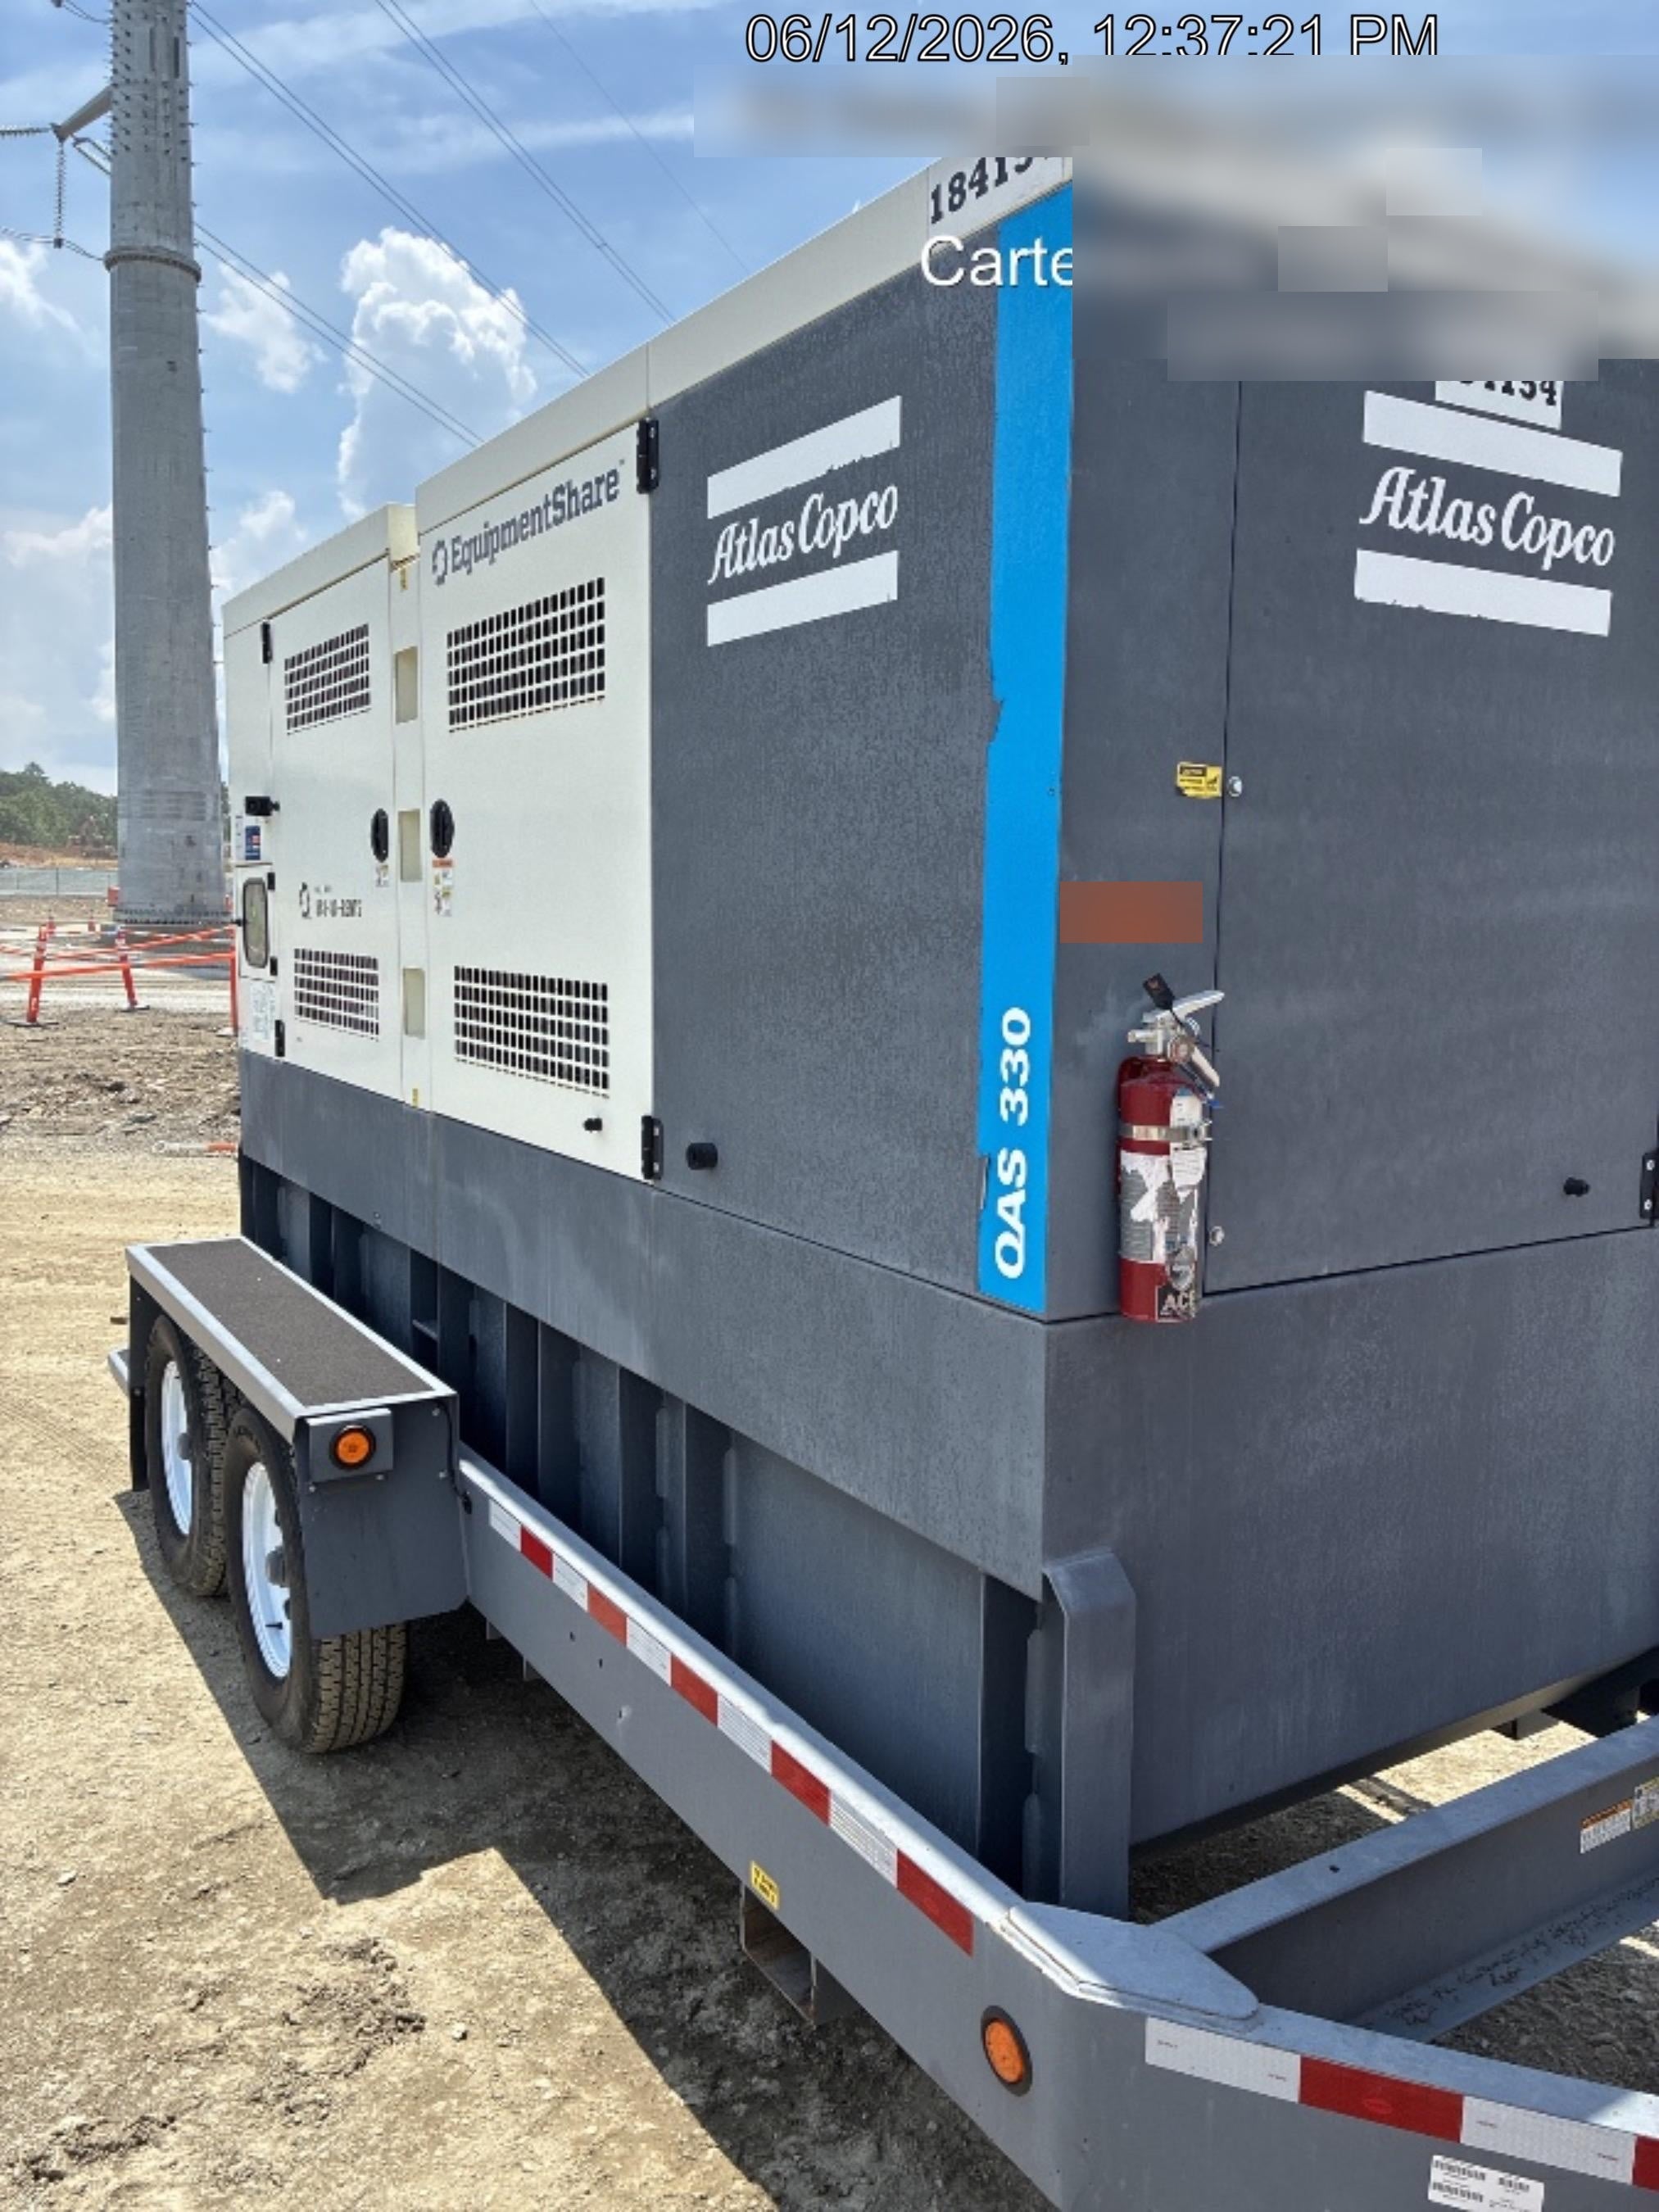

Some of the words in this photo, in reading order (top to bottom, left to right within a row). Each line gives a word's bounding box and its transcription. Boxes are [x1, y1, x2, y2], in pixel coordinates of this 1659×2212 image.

[451, 468, 620, 575] EquipmentShare
[707, 517, 795, 586] Atlas
[798, 484, 899, 559] Copco
[1359, 466, 1496, 546] Atlas
[1501, 492, 1615, 571] Copco
[999, 1007, 1031, 1126] 330
[995, 1147, 1027, 1280] QAS
